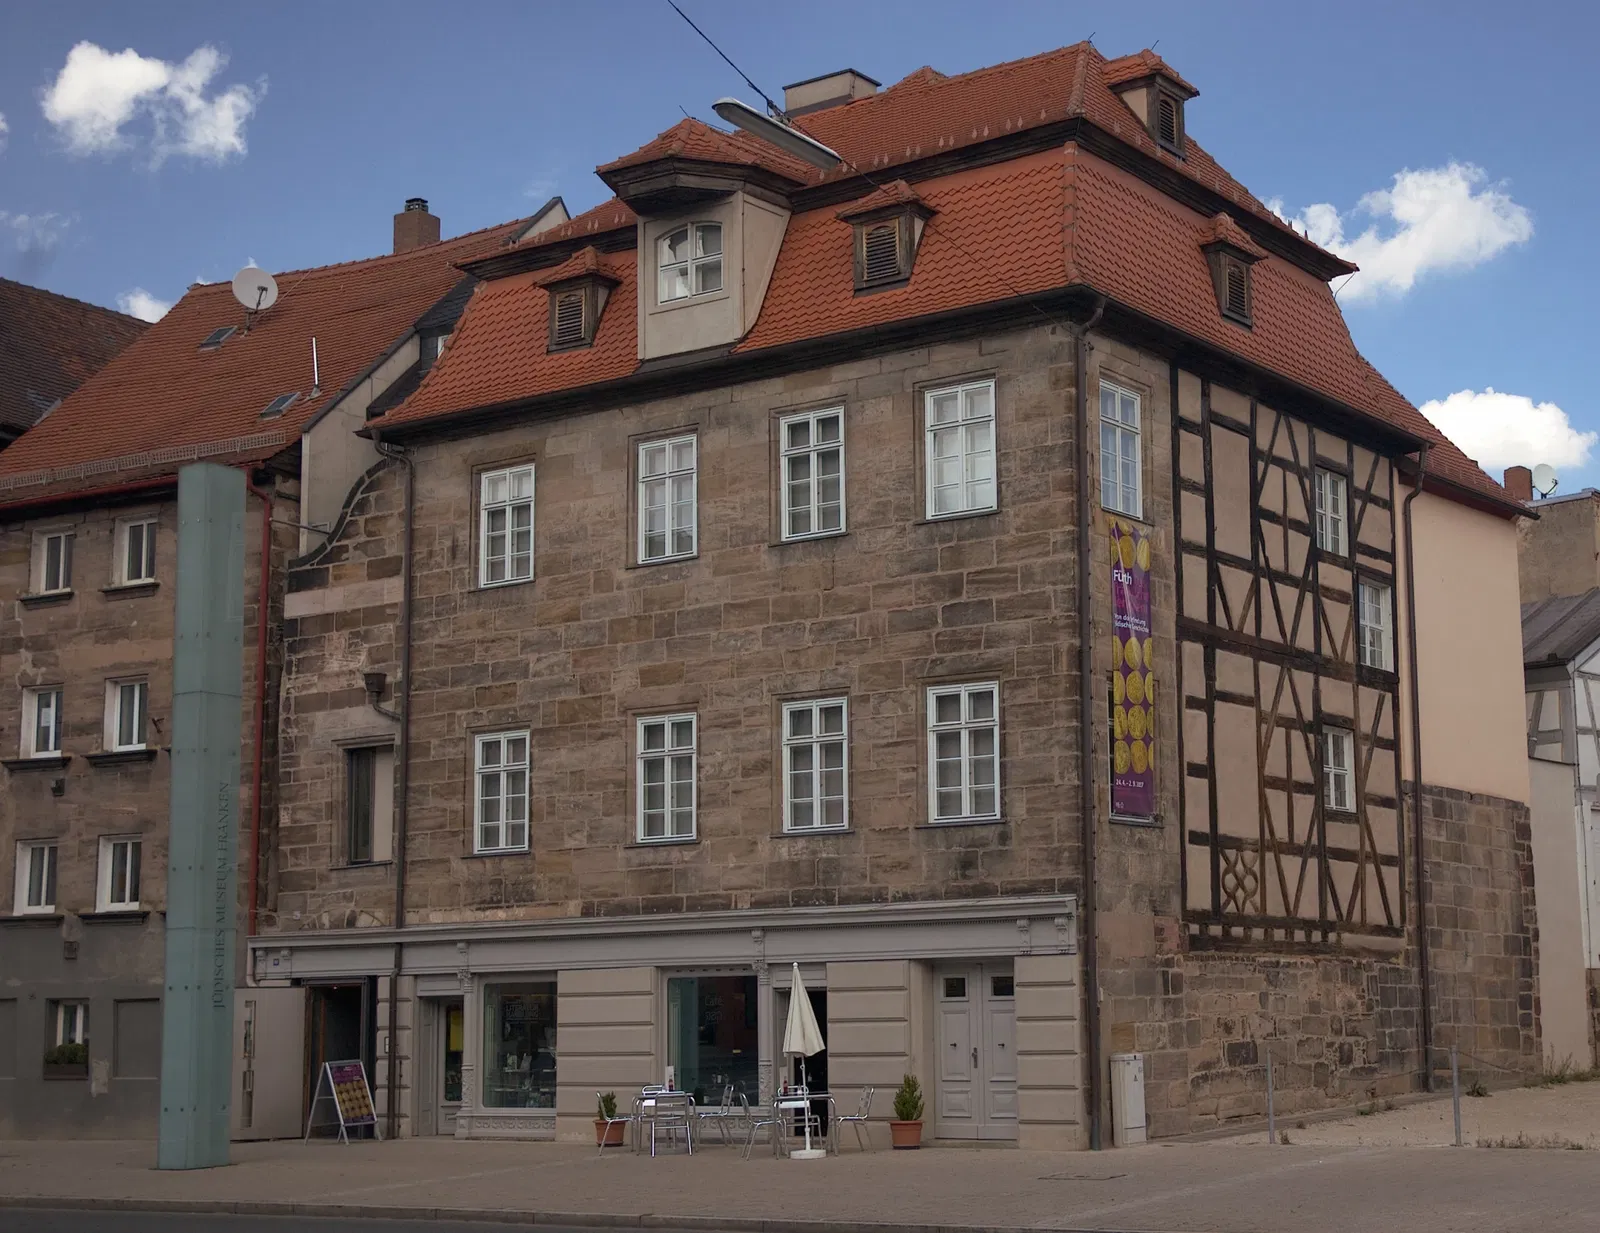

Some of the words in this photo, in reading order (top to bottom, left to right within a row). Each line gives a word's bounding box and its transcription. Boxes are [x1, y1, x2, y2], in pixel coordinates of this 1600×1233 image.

[1113, 569, 1133, 585] Fürth
[216, 782, 228, 851] FRANKEN
[215, 857, 226, 923] MUSEUM
[212, 928, 226, 1009] JÜDISCHES
